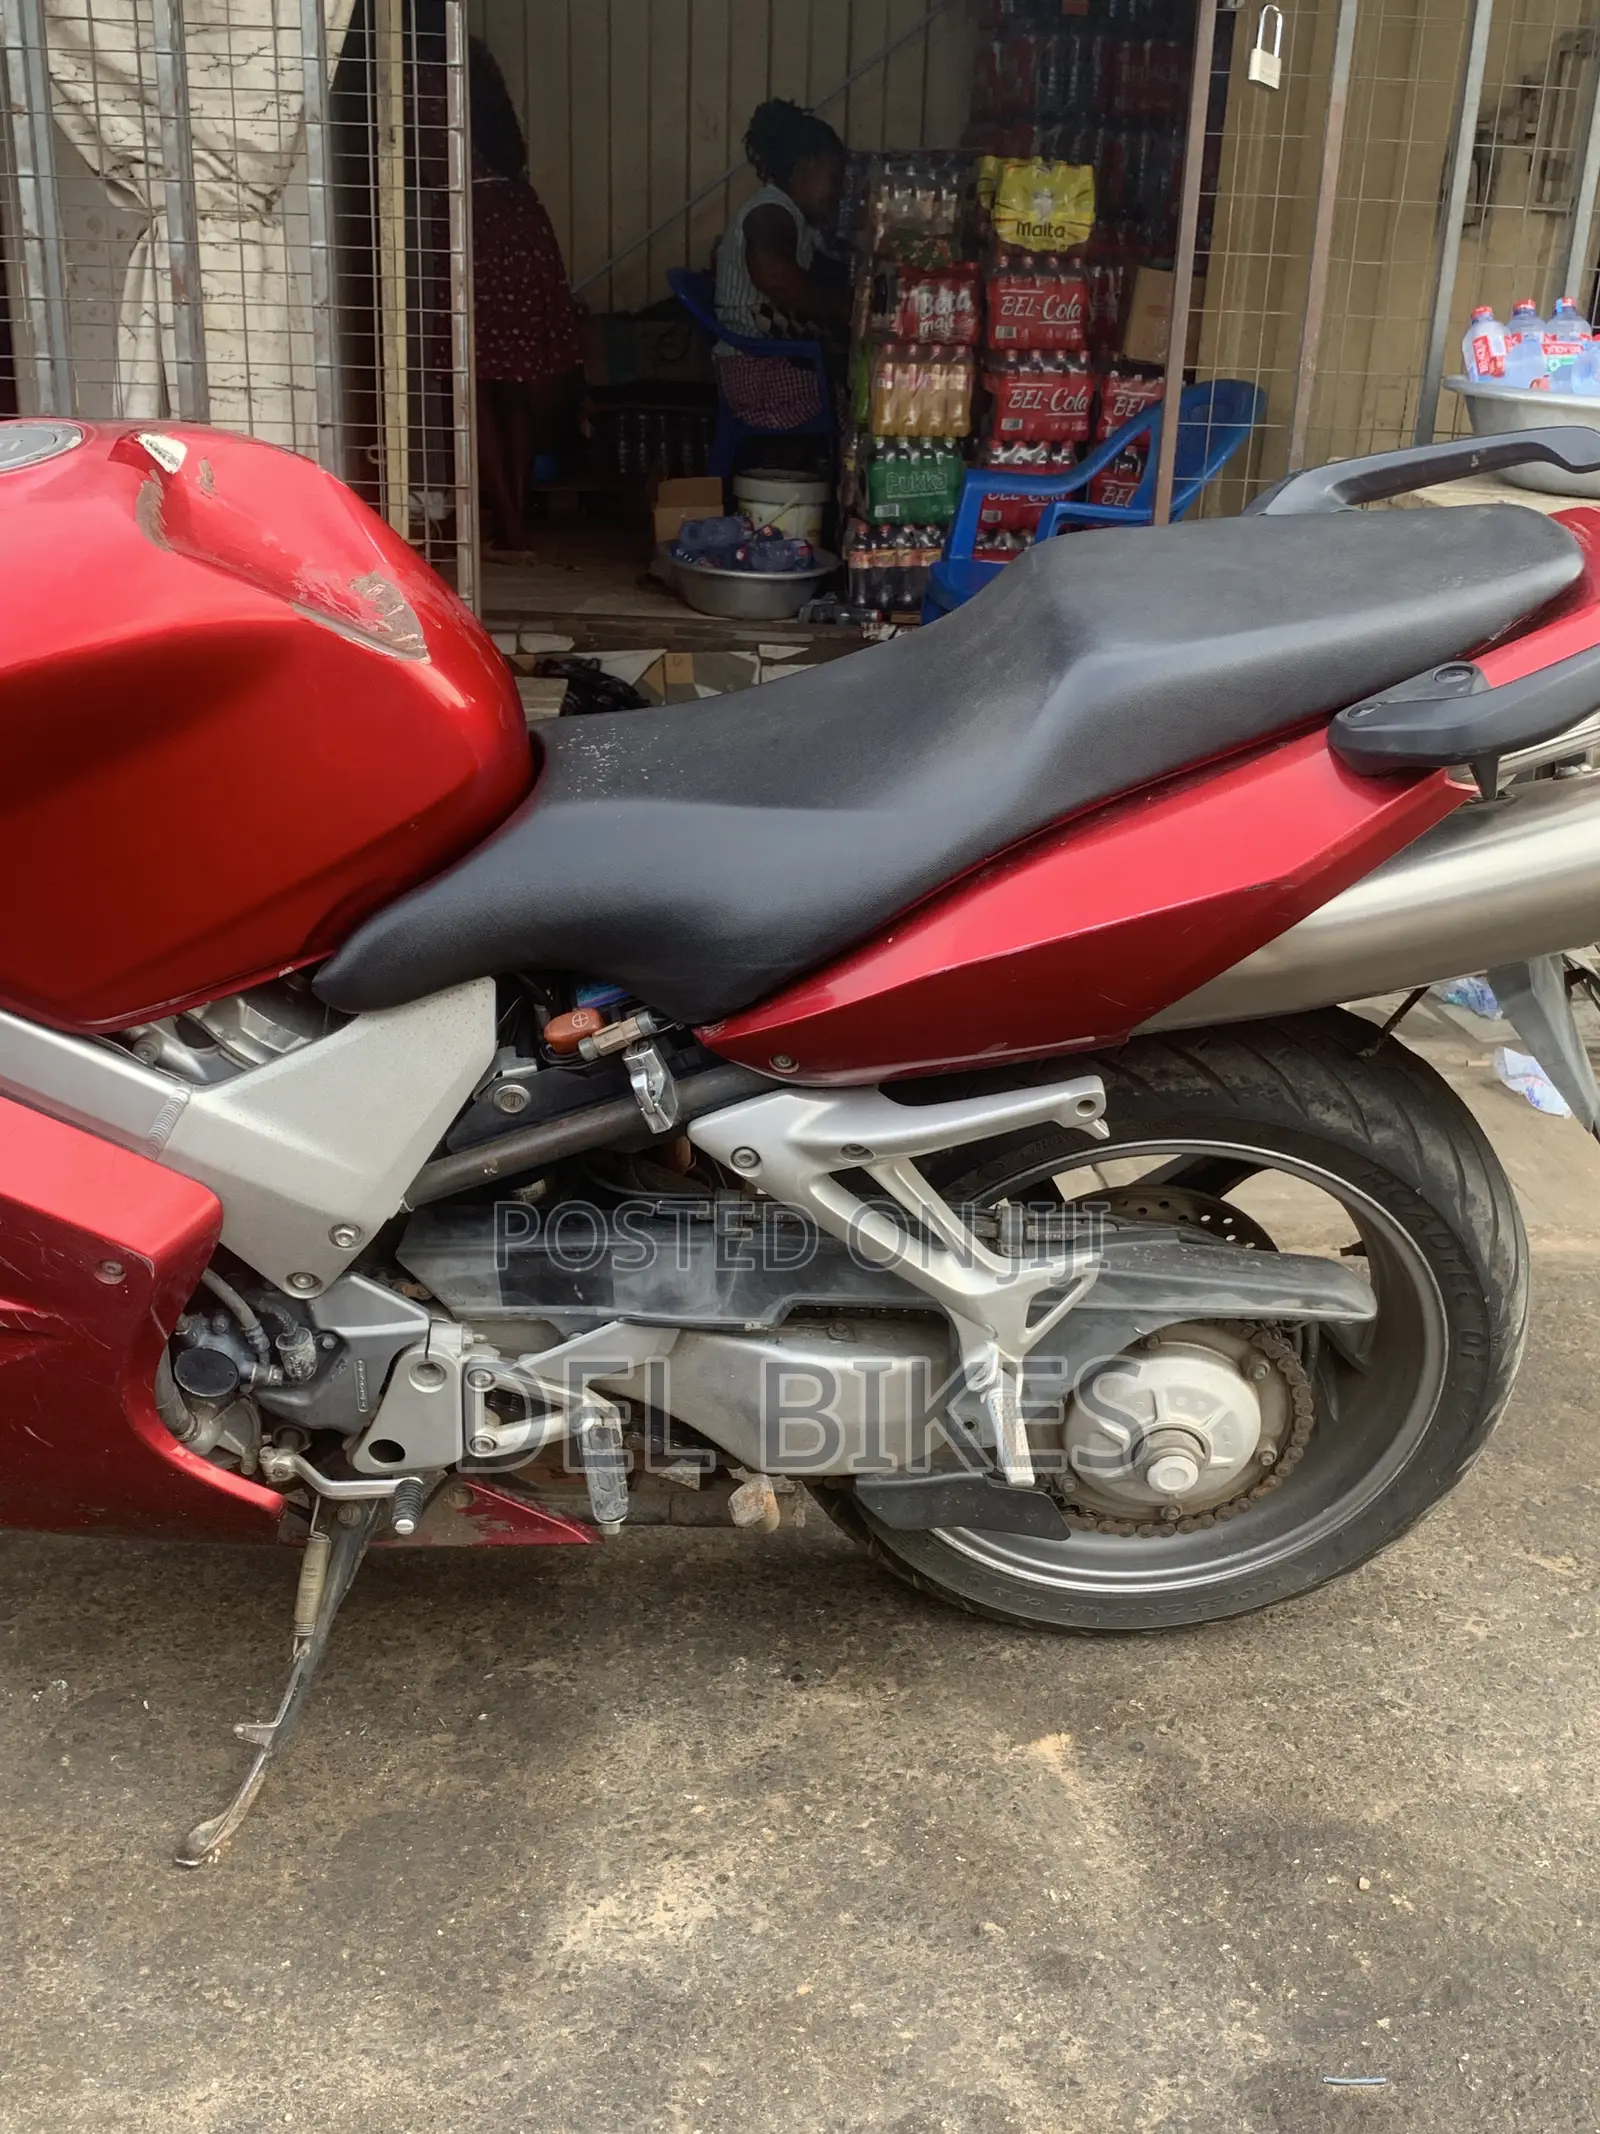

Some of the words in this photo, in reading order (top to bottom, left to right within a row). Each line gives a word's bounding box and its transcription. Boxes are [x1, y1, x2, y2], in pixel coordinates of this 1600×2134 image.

[1016, 221, 1066, 238] Malta
[1001, 293, 1082, 320] BEL-Cola
[1008, 385, 1089, 412] BEL-Cola
[886, 470, 948, 493] Pukka
